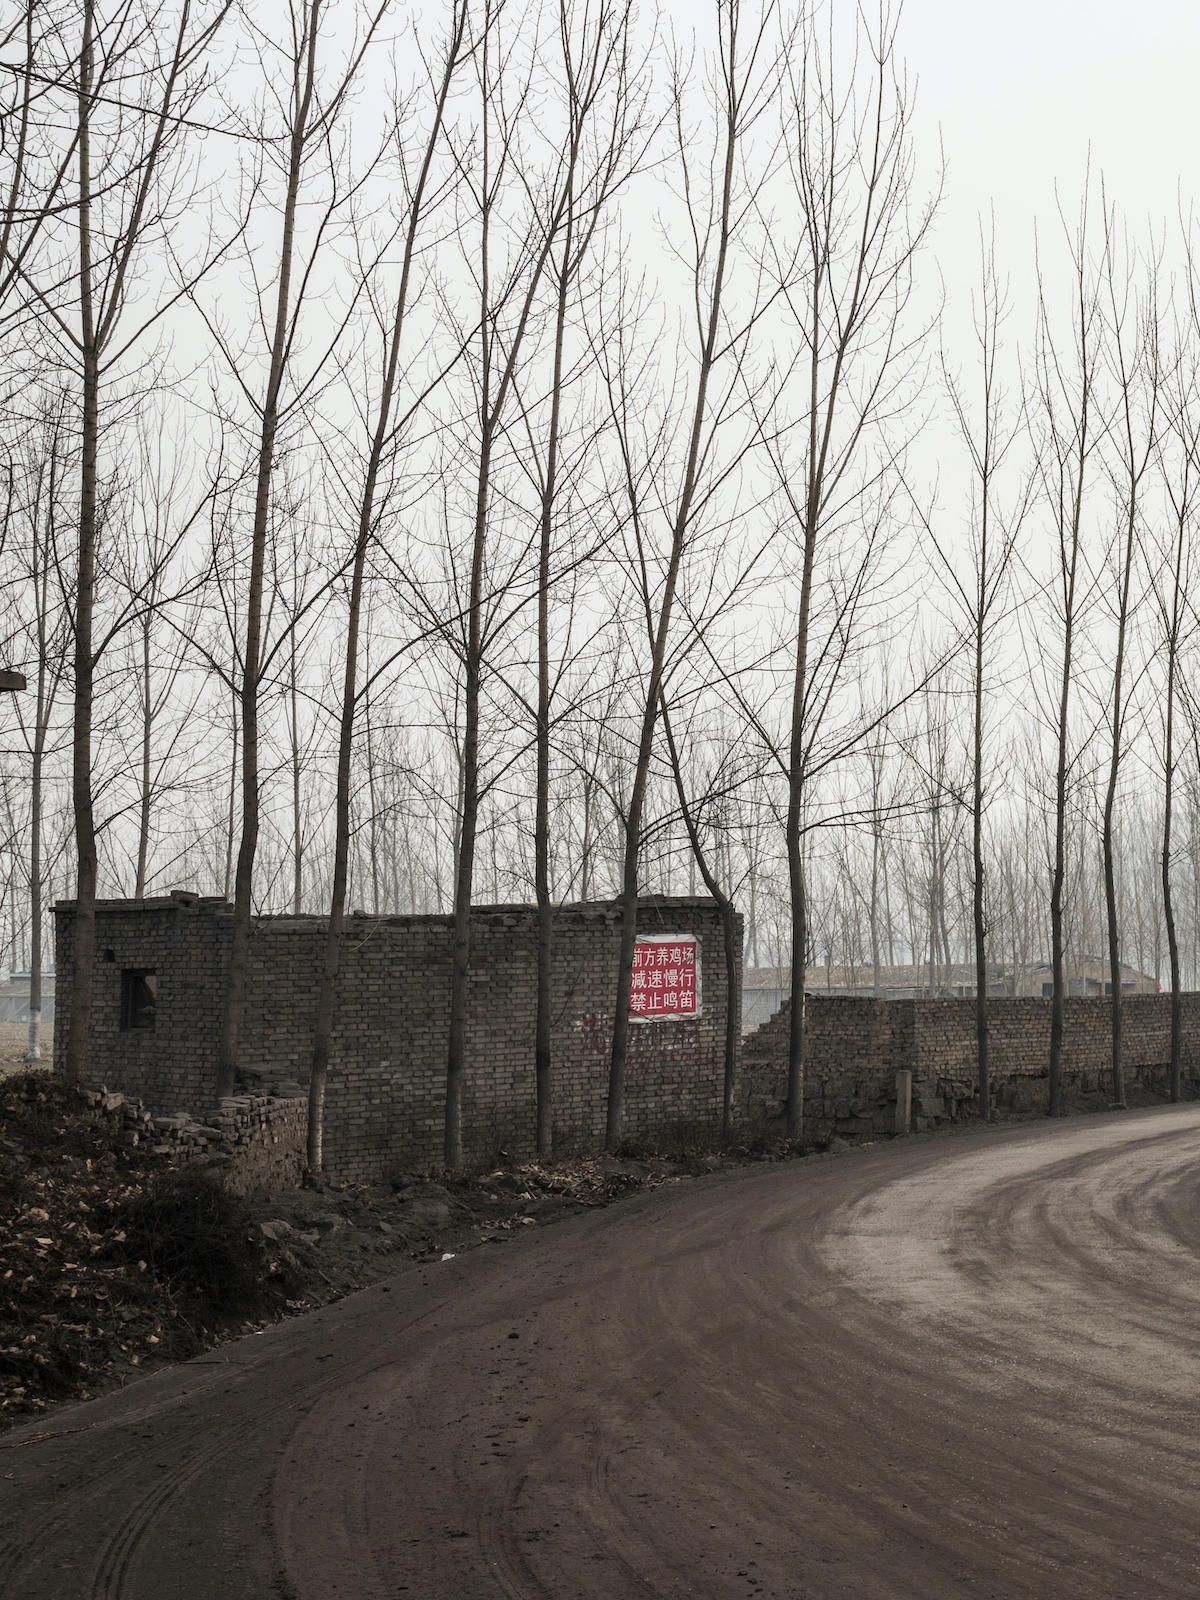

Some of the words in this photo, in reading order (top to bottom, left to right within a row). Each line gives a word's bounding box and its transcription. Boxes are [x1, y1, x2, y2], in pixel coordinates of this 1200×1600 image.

[633, 947, 694, 967] 前方养鸡场
[631, 968, 694, 989] 减速慢行
[630, 990, 694, 1011] 禁止鸣笛
